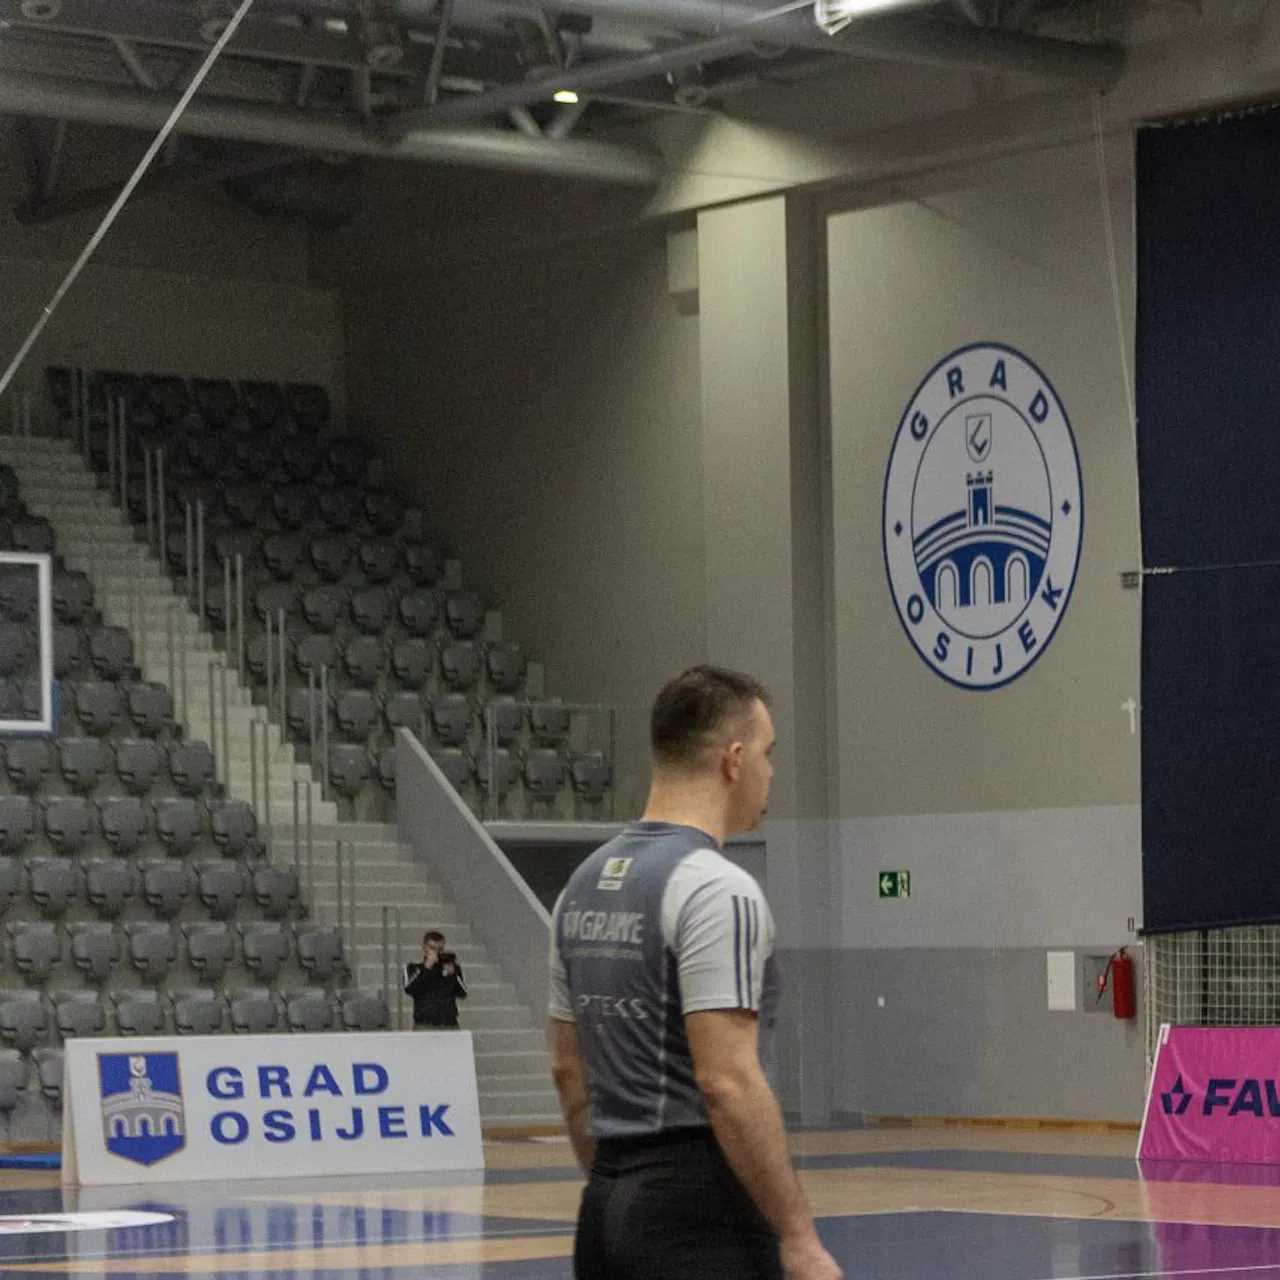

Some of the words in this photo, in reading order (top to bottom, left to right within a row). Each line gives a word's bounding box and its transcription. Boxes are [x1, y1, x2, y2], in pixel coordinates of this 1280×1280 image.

[910, 359, 1049, 441] GRAD
[907, 573, 1064, 676] OSIJEK
[206, 1063, 390, 1100] GRAD
[210, 1104, 456, 1146] OSIJEK
